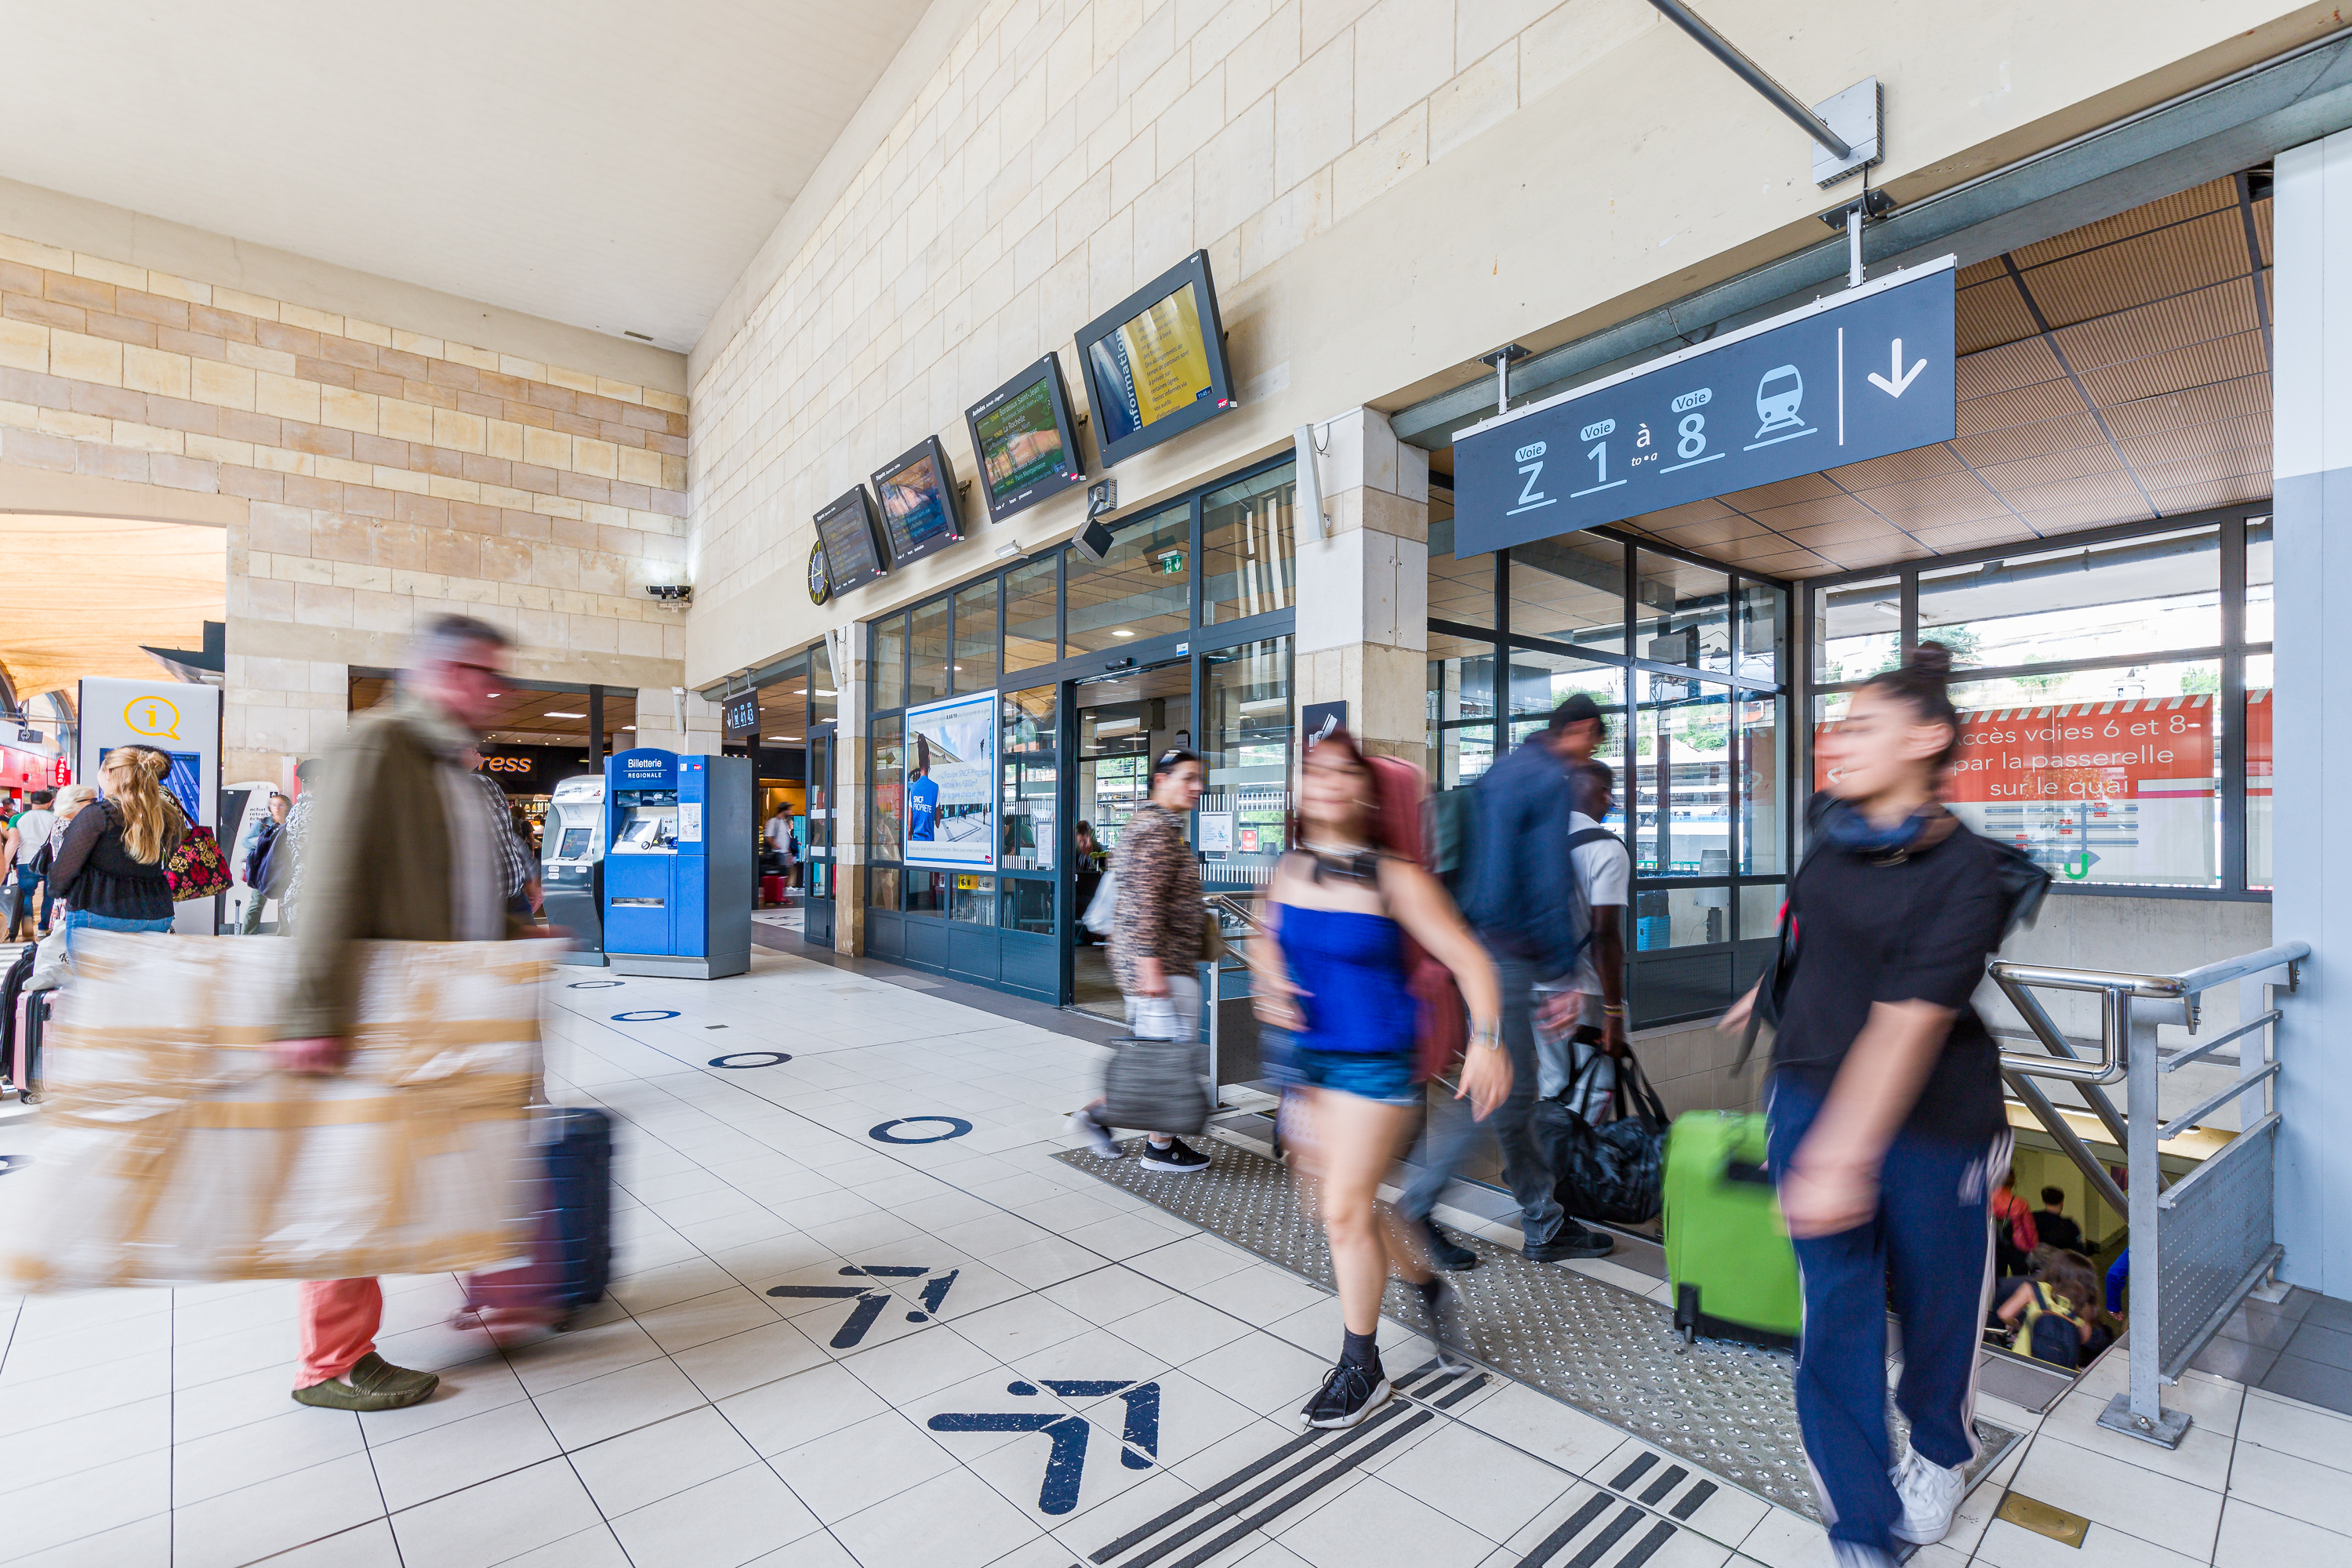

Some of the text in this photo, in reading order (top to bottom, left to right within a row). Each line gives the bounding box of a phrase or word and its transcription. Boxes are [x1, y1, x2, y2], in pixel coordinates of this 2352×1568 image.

[1146, 365, 1158, 377] temps
[1158, 362, 1163, 371] de
[1116, 330, 1141, 431] information
[1150, 382, 1167, 394] certaines
[1000, 401, 1018, 416] Bordeaux
[1018, 387, 1040, 405] Saint-Jean
[1160, 399, 1171, 409] outils
[1218, 400, 1228, 408] SNCF
[1676, 394, 1705, 409] Voie
[1008, 415, 1025, 430] Rochelle
[1584, 423, 1610, 437] Voie
[1678, 413, 1706, 459] 8
[1519, 445, 1541, 459] Voie
[1588, 423, 1650, 482] 1 à
[1519, 460, 1544, 505] Z
[741, 709, 753, 724] 41 43
[2024, 723, 2094, 742] voies
[2103, 720, 2120, 738] 6
[2130, 720, 2159, 736] et
[628, 759, 662, 768] Billetterie
[1954, 744, 2174, 776] par la passerelle
[1990, 775, 2128, 799] sur le quai
